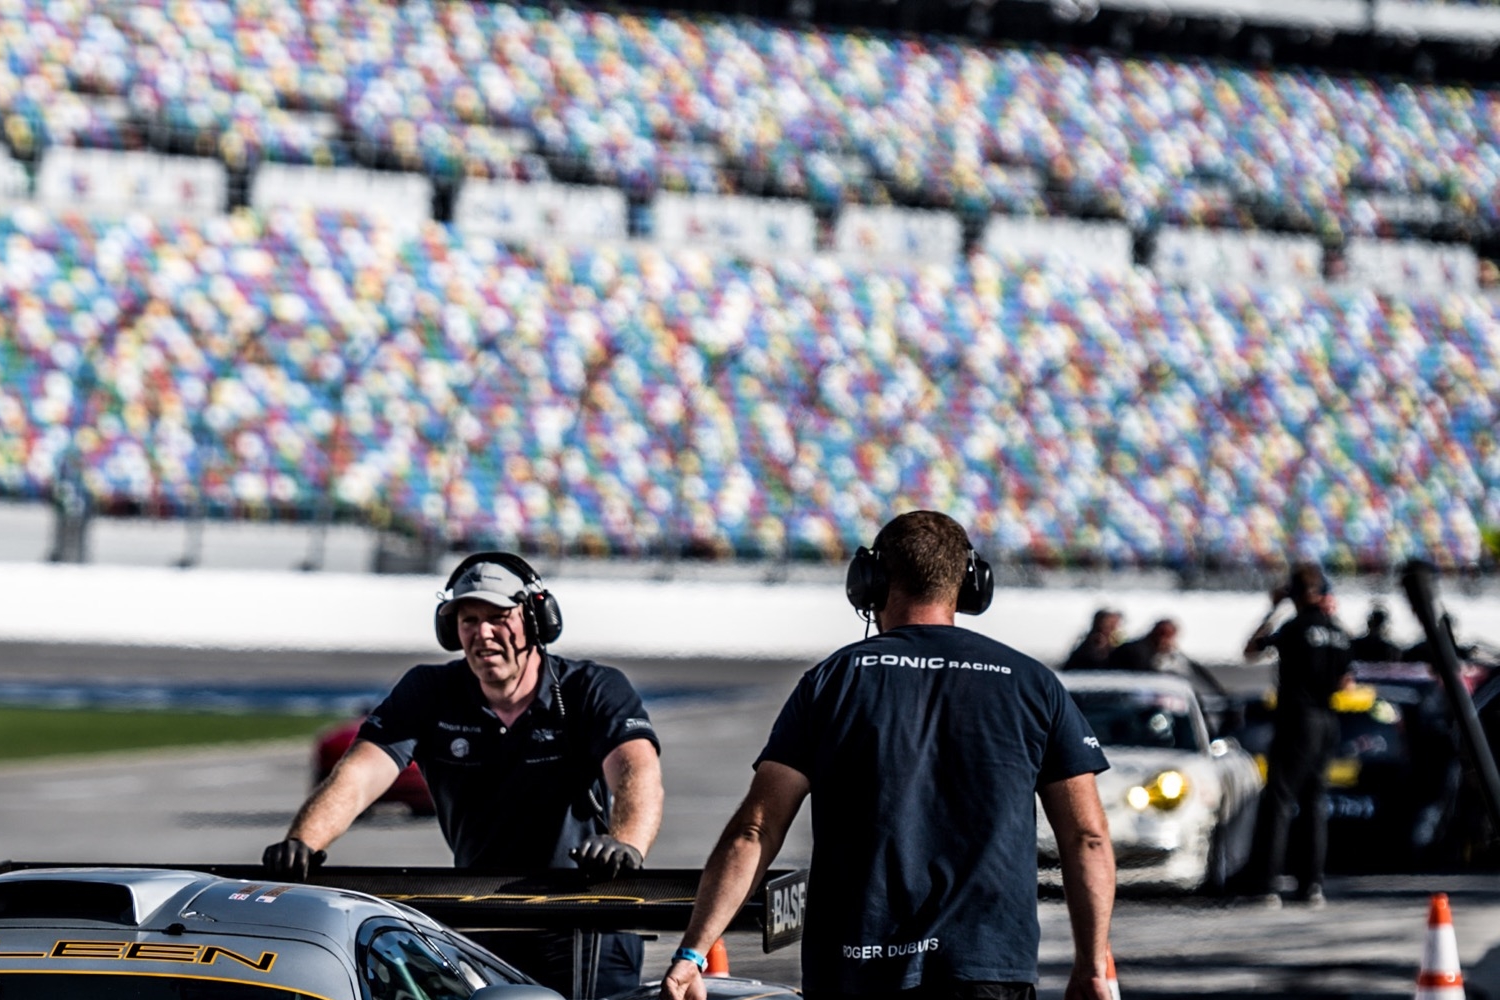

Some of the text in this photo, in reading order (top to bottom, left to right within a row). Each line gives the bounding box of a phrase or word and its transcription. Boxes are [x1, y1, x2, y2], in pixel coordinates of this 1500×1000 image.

[855, 654, 1012, 675] ICONIC RACING
[887, 937, 939, 957] DUBUIS
